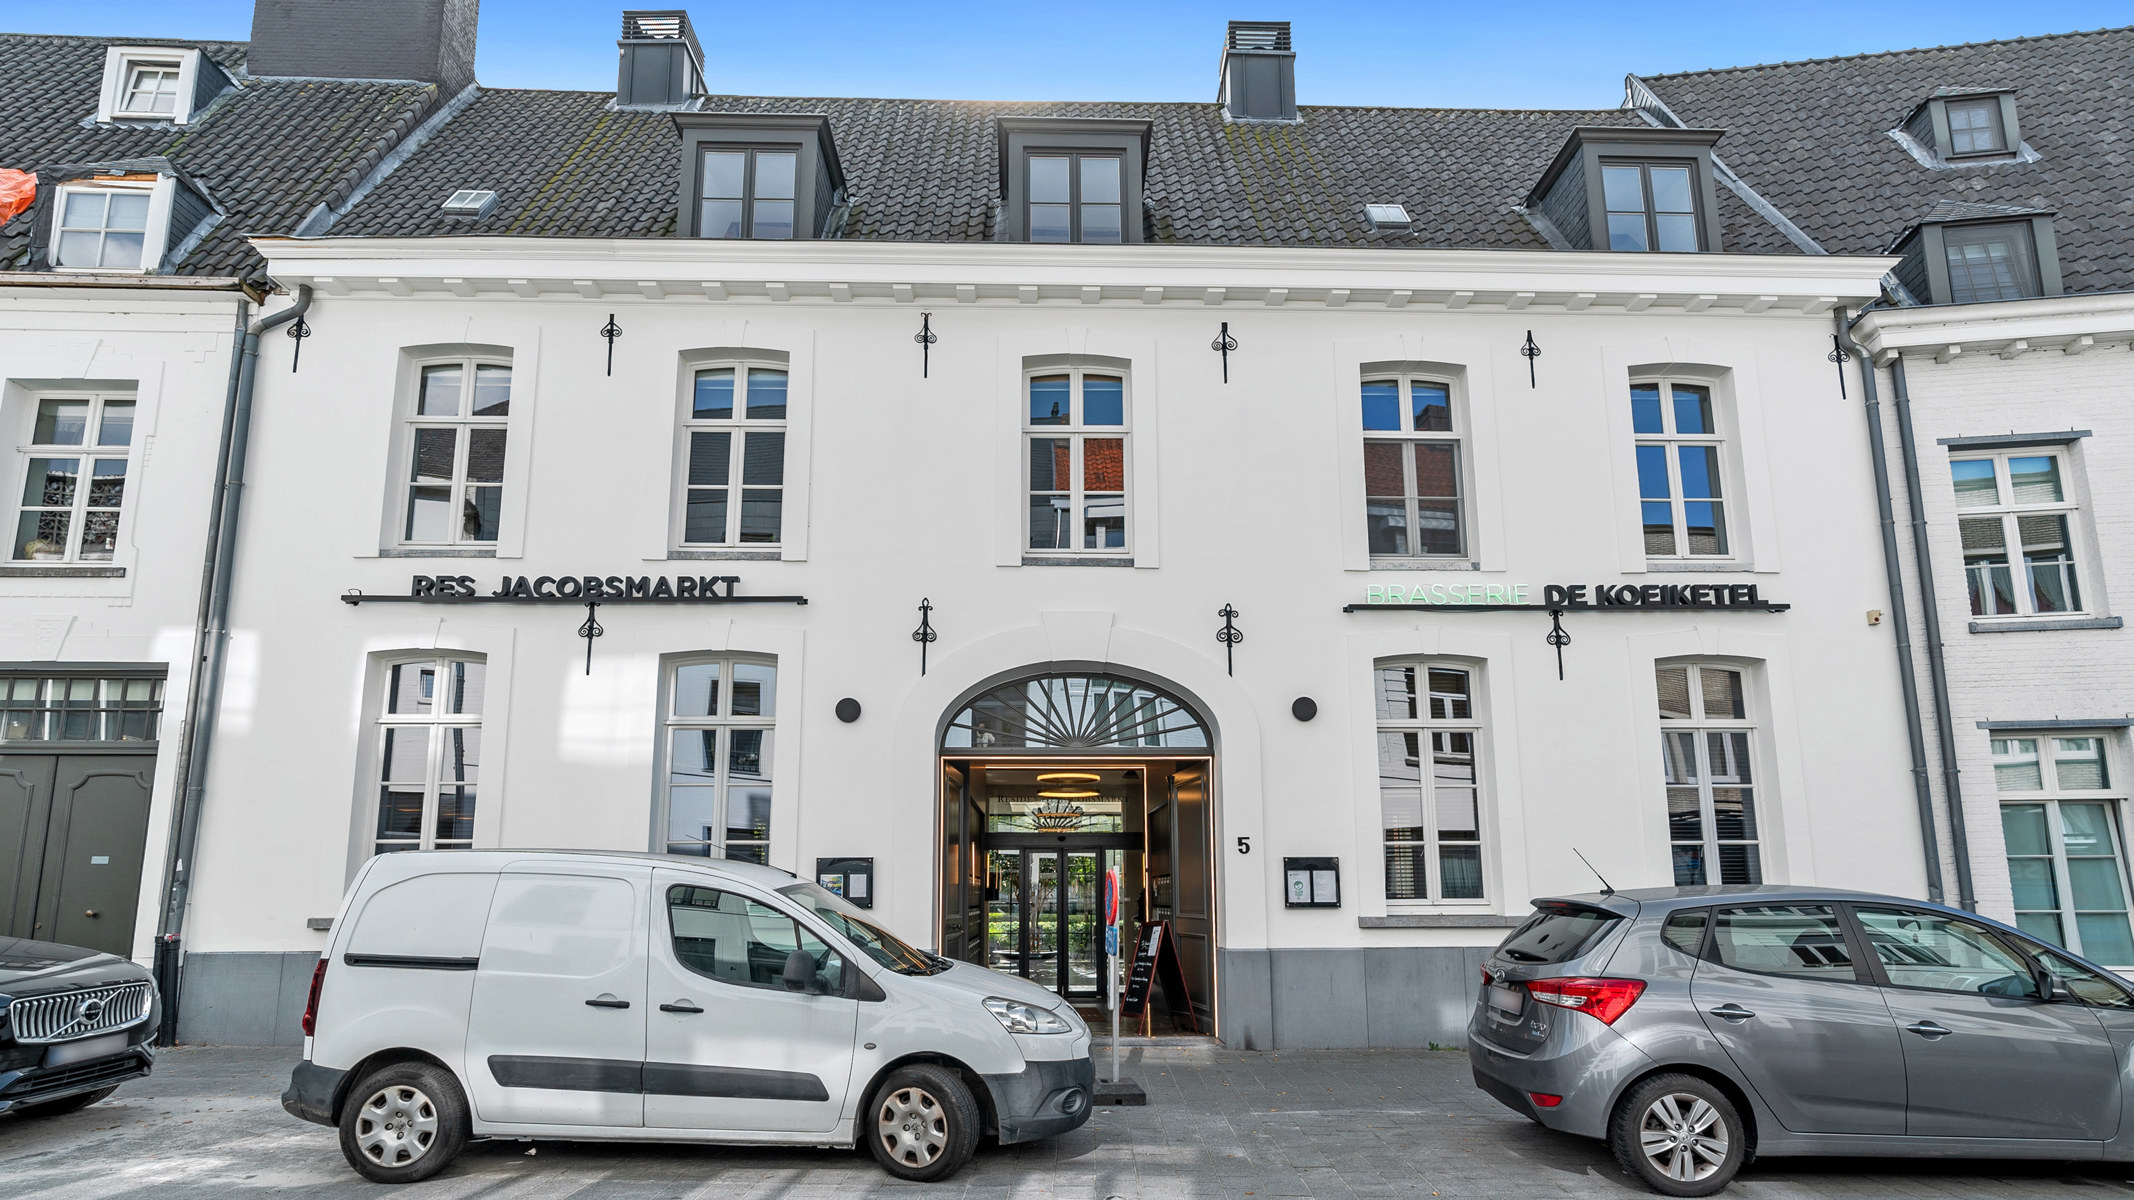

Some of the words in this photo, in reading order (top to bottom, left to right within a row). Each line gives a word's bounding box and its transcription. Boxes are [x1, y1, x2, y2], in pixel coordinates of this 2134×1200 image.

[411, 574, 476, 598] RES
[492, 575, 741, 598] JACOBSMARKT
[1366, 583, 1530, 605] BRASSERIE
[1543, 584, 1588, 606] DE
[1595, 584, 1769, 606] KOEIKETEL
[1237, 836, 1251, 855] 5
